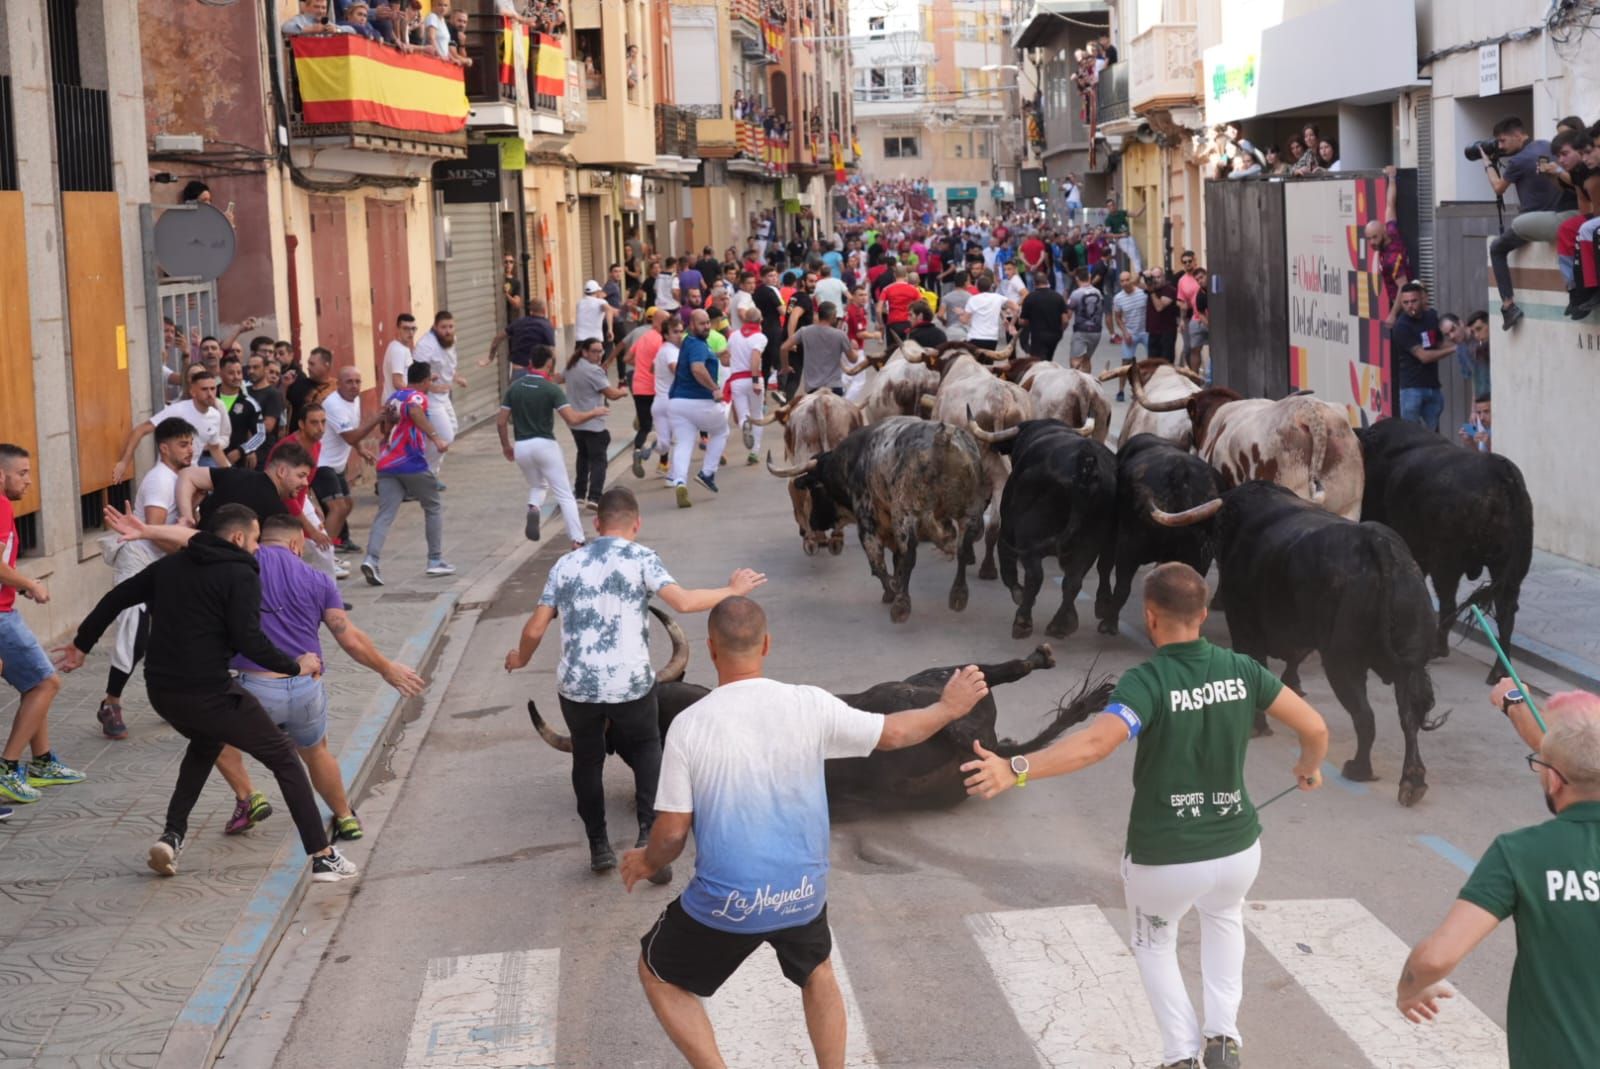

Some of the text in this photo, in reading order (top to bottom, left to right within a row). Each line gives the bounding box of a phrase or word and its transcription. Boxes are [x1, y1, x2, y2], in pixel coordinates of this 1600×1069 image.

[1171, 793, 1204, 807] ESPORTS
[1546, 870, 1600, 901] PAS
[711, 890, 747, 922] La
